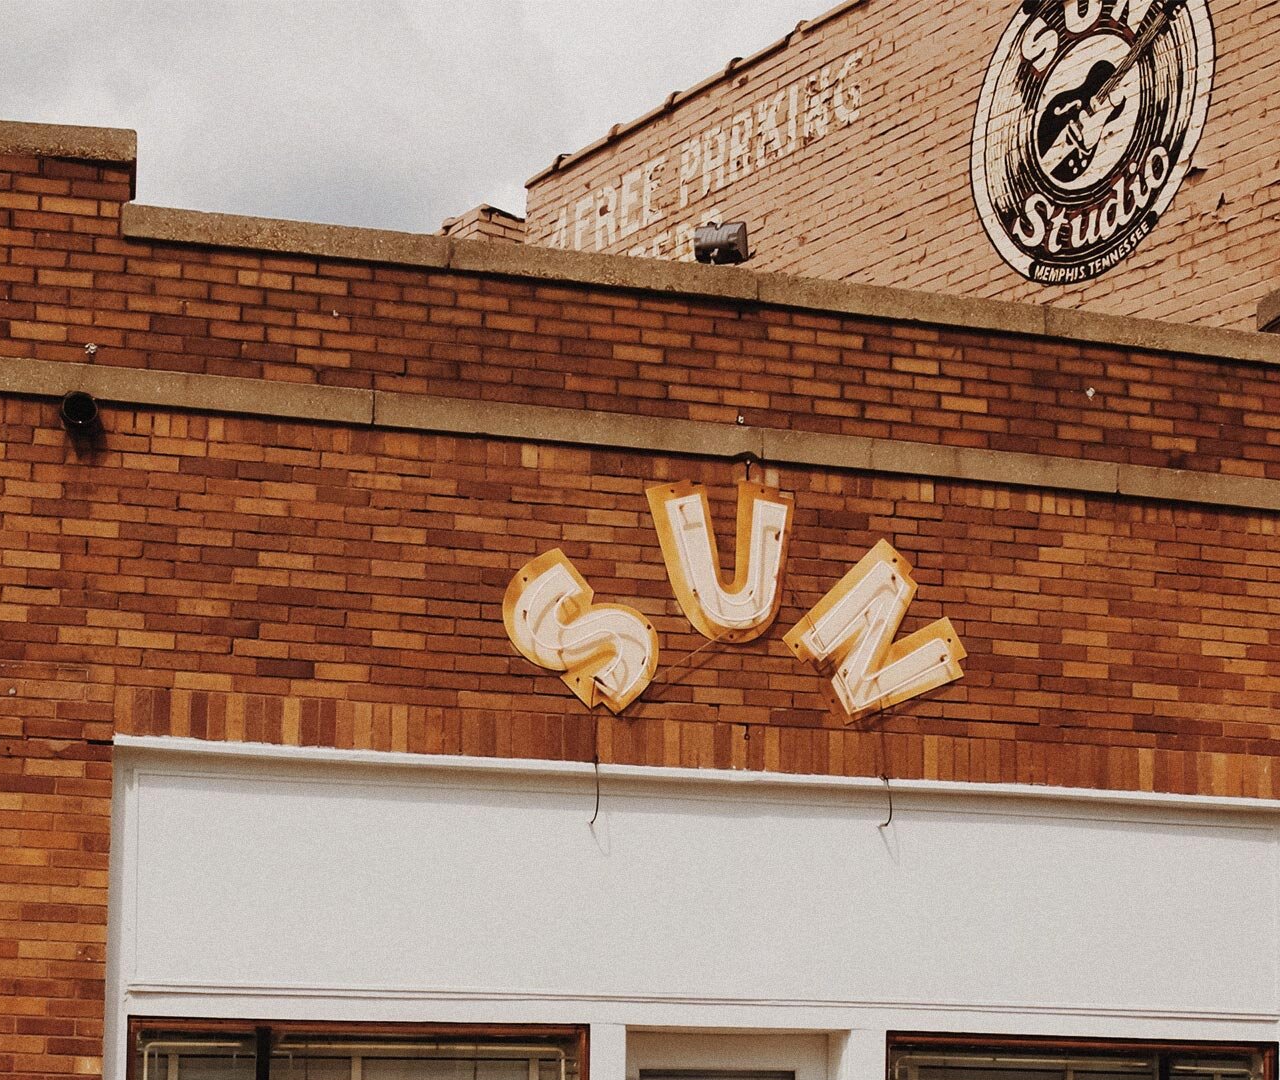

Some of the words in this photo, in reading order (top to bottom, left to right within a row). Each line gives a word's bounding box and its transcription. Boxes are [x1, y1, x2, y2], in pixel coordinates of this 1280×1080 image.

[575, 156, 666, 251] FREE
[1013, 146, 1170, 253] Studio
[1088, 221, 1150, 274] TENNESSEE
[502, 480, 967, 725] SUN
